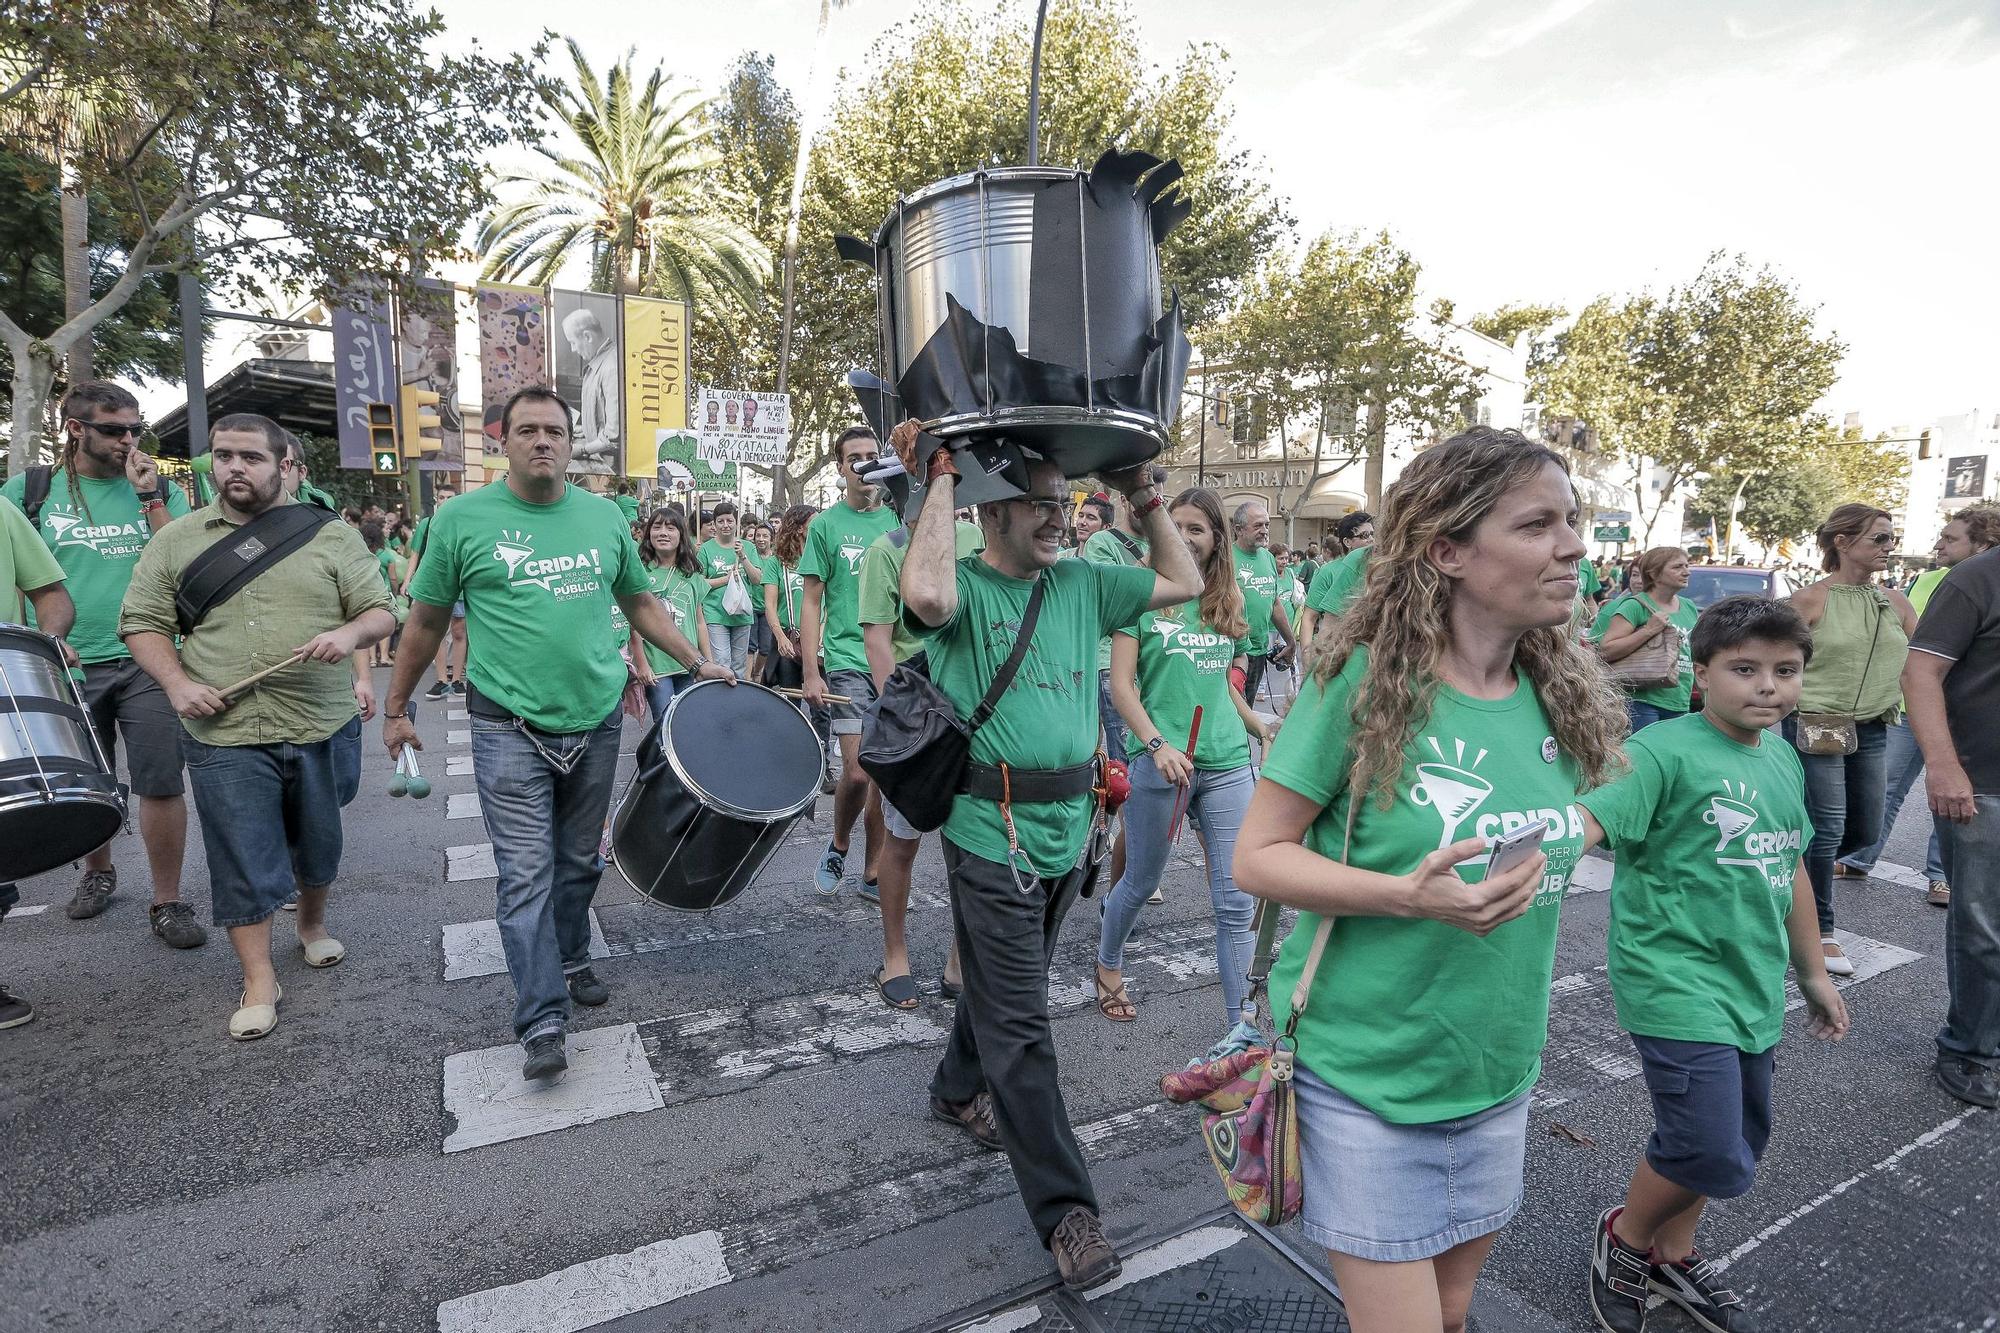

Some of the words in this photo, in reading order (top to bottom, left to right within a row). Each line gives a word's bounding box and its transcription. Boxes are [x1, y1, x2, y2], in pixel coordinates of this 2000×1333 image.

[632, 347, 659, 423] miró
[706, 389, 718, 400] EL
[721, 390, 753, 401] GOVERN
[757, 392, 786, 404] BALEAR
[703, 424, 720, 432] MONO
[741, 426, 760, 434] MONO
[731, 450, 741, 461] LA
[1189, 468, 1307, 489] RESTAURANT
[100, 544, 143, 556] PÚBLIC
[524, 548, 602, 577] CRIDA!
[553, 580, 600, 597] PÚBLICA
[1177, 632, 1231, 647] CRIDA
[1548, 846, 1570, 858] PER
